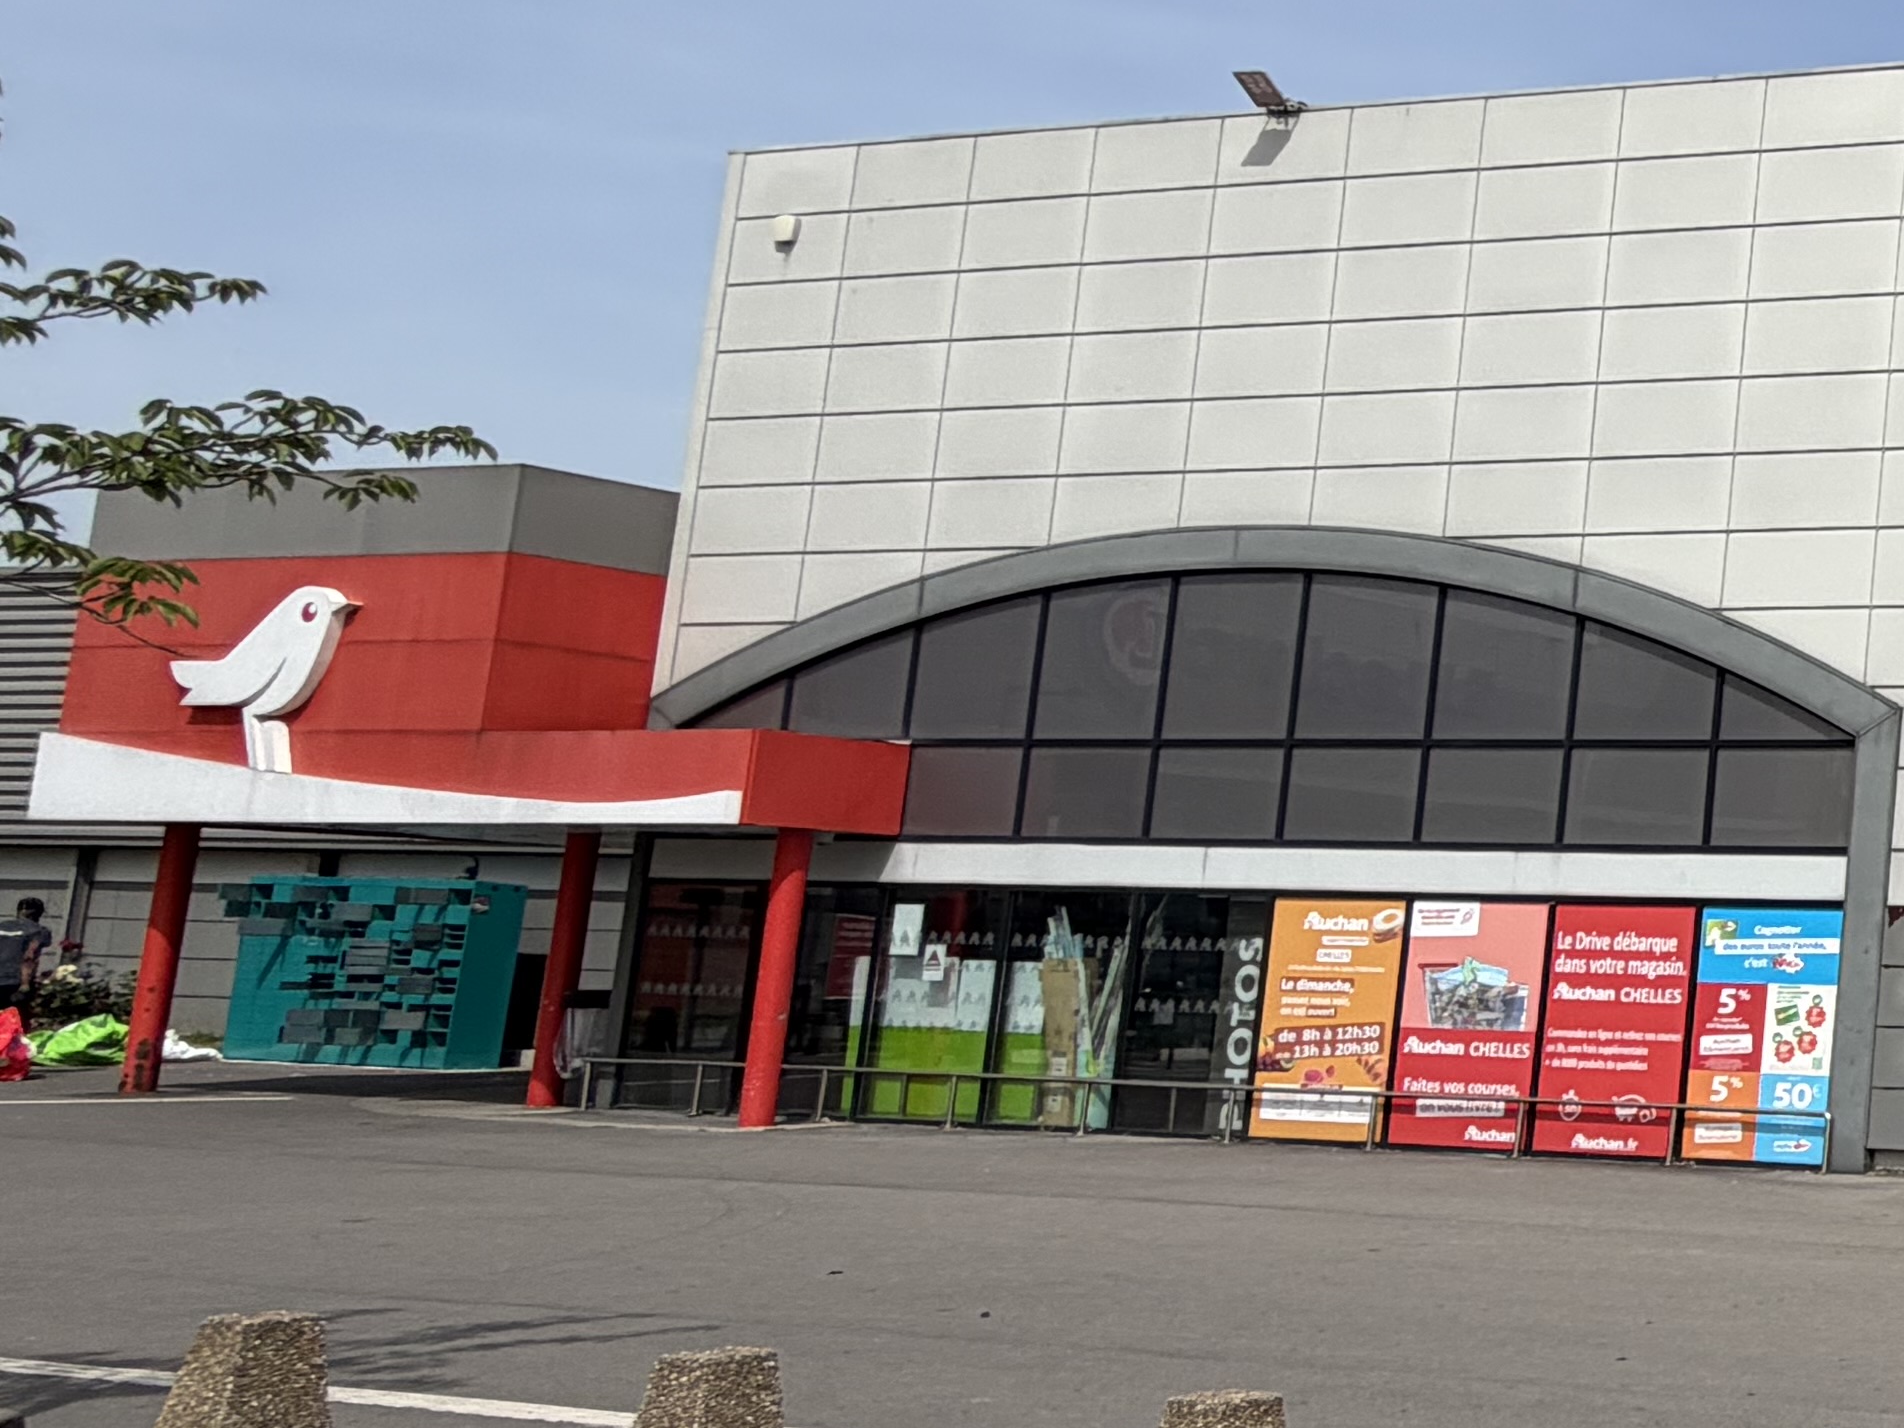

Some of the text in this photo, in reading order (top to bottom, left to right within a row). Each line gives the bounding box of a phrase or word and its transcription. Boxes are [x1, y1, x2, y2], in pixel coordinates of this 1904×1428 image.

[1304, 911, 1369, 930] Auchan
[1557, 931, 1678, 956] Le Drive débarque
[1555, 953, 1687, 980] dans votre magasin.
[1281, 978, 1354, 994] Le dimanche,
[1552, 982, 1683, 1004] Auchan CHELLES
[1717, 988, 1752, 1014] 5%
[1278, 1025, 1381, 1042] de 8h à 12h30
[1294, 1044, 1319, 1058] 13h
[1322, 1042, 1331, 1056] à
[1335, 1041, 1379, 1055] 20h30
[1403, 1036, 1530, 1059] Auchan CHELLES
[1403, 1077, 1440, 1093] Faites
[1443, 1082, 1465, 1093] vos
[1710, 1075, 1744, 1102] 5%
[1772, 1081, 1822, 1110] 50€
[1464, 1125, 1515, 1143] Auchan
[1570, 1133, 1638, 1152] Auchan.fr
